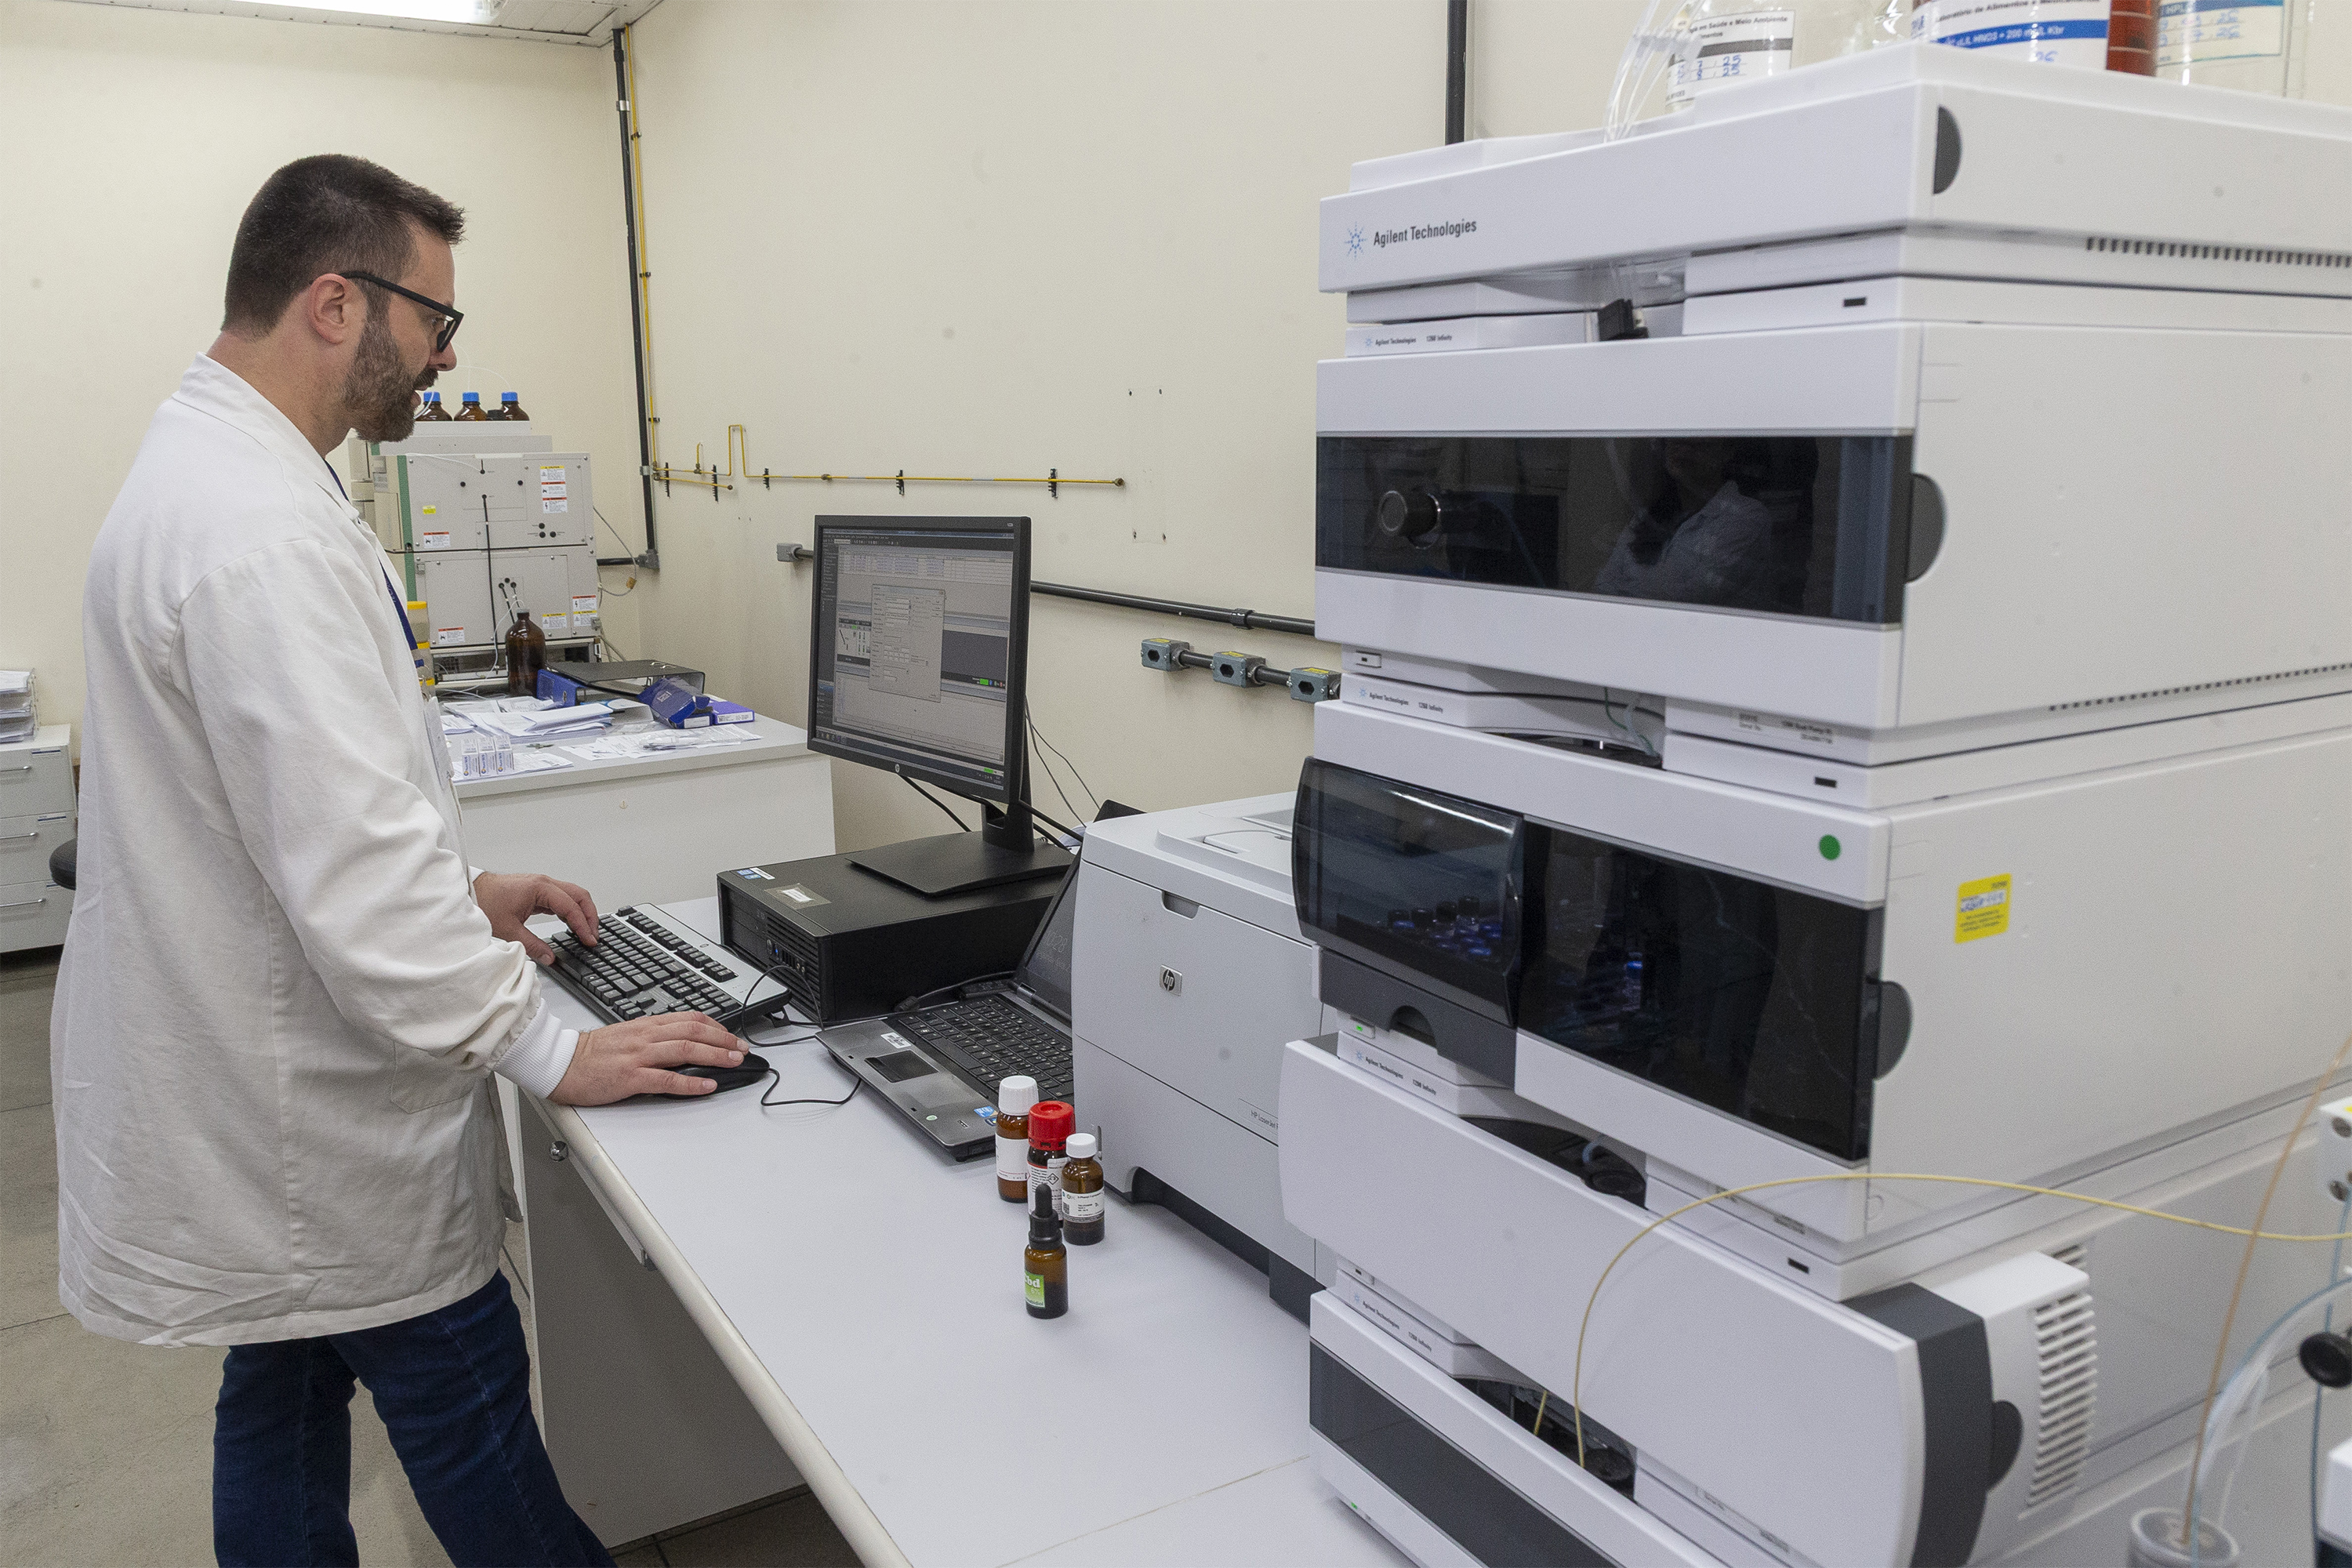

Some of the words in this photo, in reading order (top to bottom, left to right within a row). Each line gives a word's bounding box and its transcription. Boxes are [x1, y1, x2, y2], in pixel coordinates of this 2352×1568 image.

[1709, 20, 1728, 30] Saúde
[1374, 229, 1408, 248] Agilent
[1410, 219, 1477, 241] Technologies
[1390, 337, 1417, 346] Technologies
[1384, 695, 1408, 706] Technologies
[1163, 969, 1175, 992] hp
[1366, 1056, 1378, 1067] Agilent
[1379, 1062, 1403, 1079] Technologies
[1363, 1301, 1376, 1313] Agilent
[1376, 1309, 1400, 1330] Technologies
